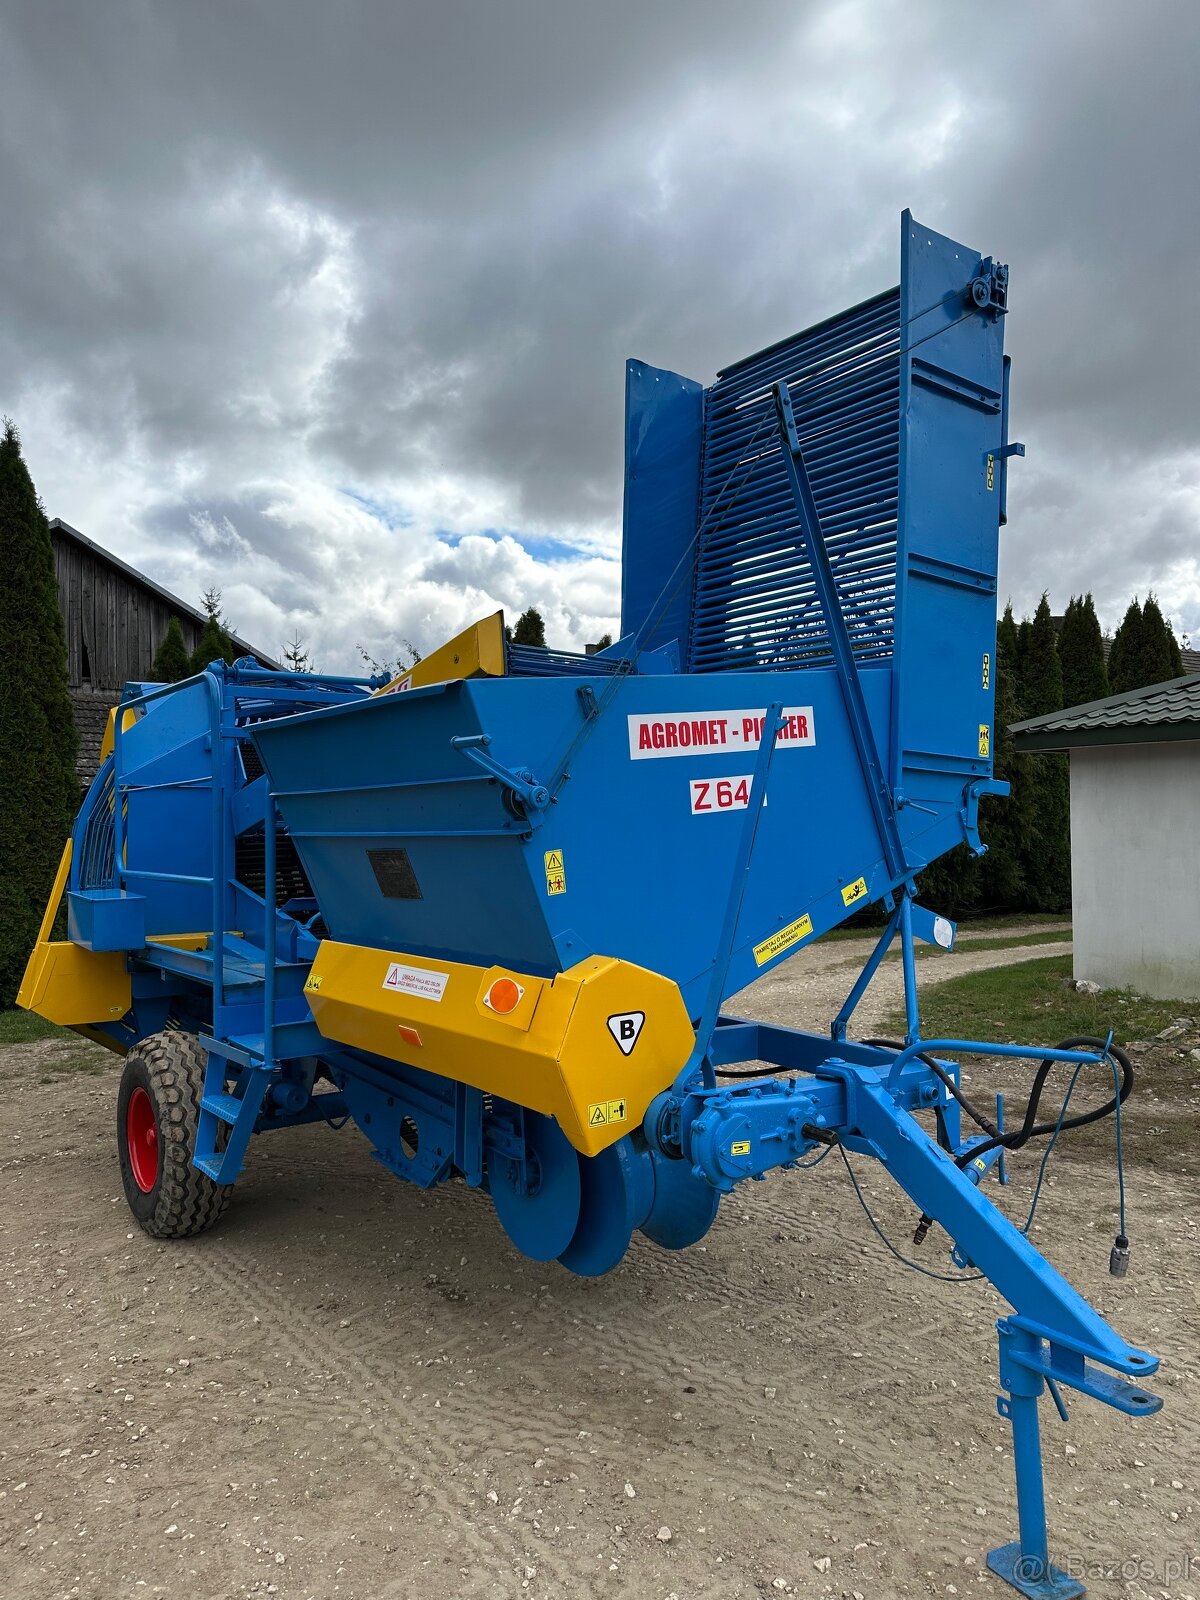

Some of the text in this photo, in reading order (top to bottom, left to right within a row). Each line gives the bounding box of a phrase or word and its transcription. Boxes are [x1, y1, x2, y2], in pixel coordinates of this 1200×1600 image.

[639, 719, 728, 750] AGROMET
[742, 715, 809, 743] PIIER
[694, 782, 712, 810] Z
[620, 1019, 635, 1040] B
